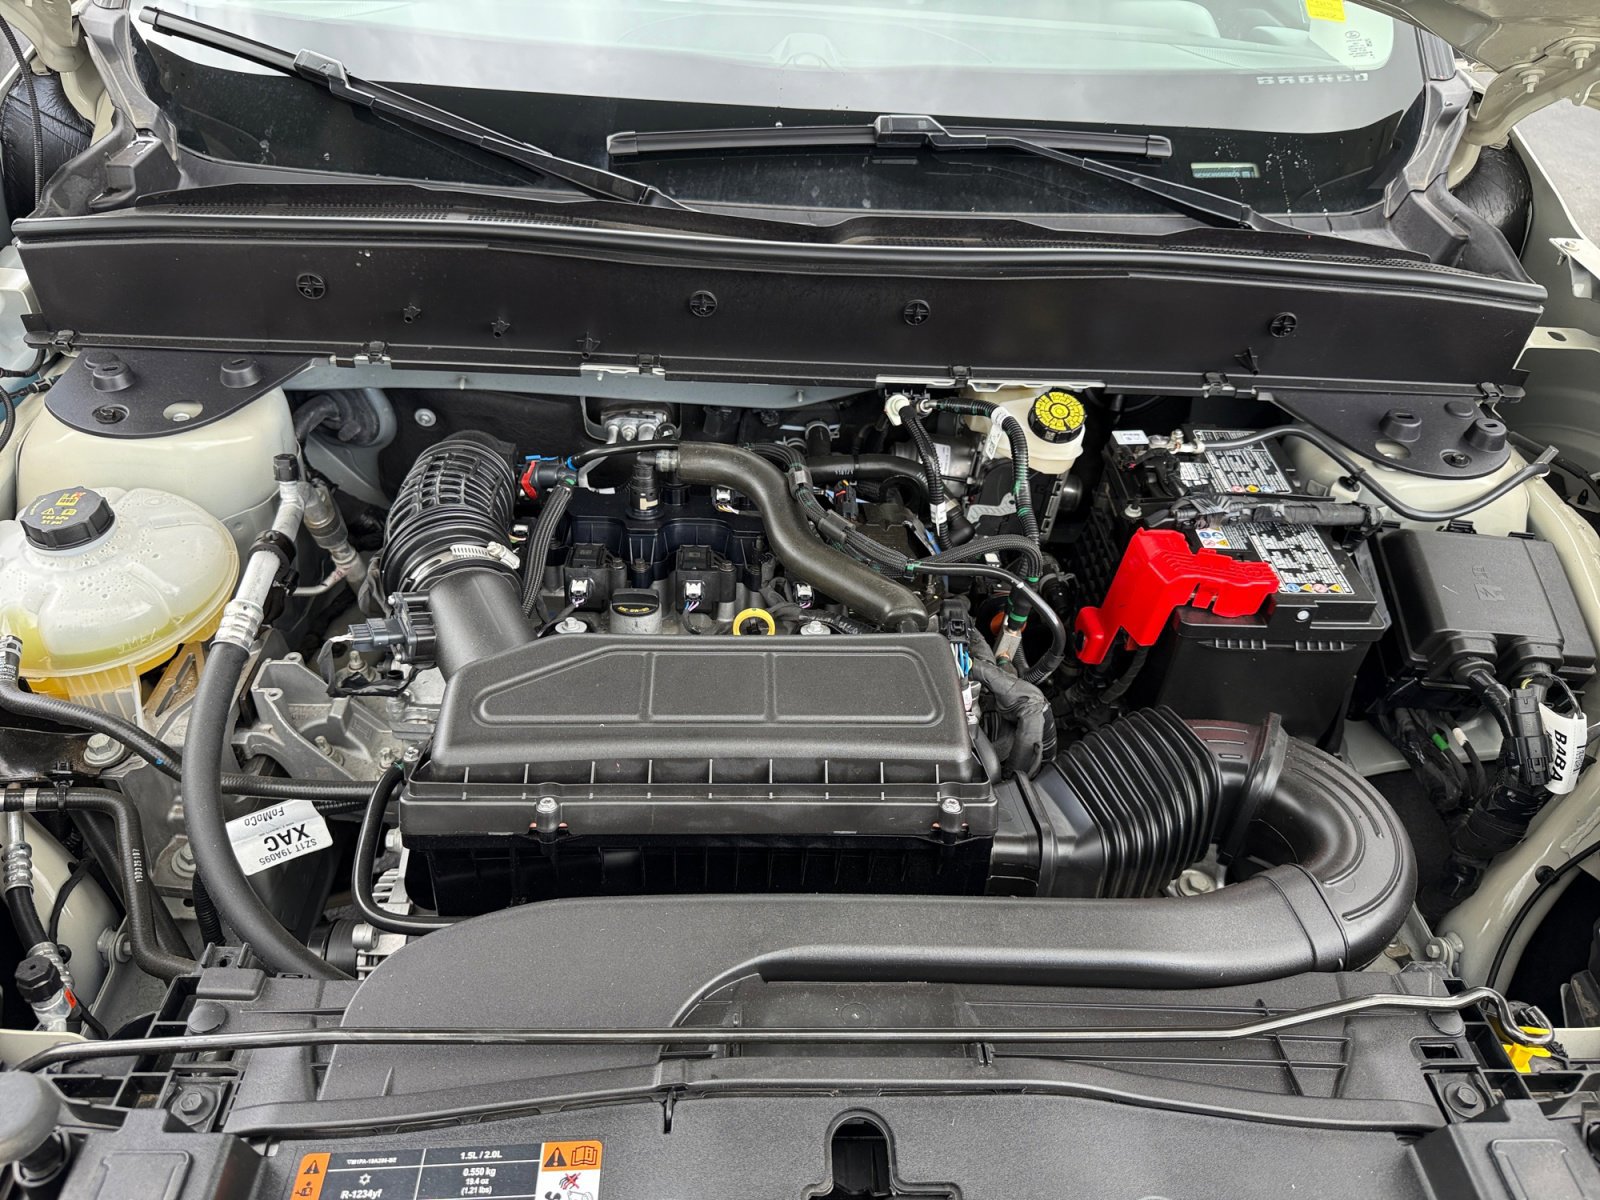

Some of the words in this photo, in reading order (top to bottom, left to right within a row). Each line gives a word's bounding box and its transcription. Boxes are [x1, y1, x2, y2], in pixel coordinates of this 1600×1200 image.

[1256, 72, 1369, 84] BRONCO
[1550, 730, 1567, 781] BABA
[243, 806, 286, 828] FoMoCo
[263, 823, 311, 852] XAC
[295, 838, 318, 853] SZ1T
[258, 847, 292, 866] 19A095
[460, 1151, 478, 1160] 1.5L
[483, 1150, 503, 1159] 2.0L
[462, 1167, 485, 1177] 0.550
[485, 1166, 497, 1178] kg
[340, 1188, 383, 1200] R-1234yf
[460, 1186, 478, 1196] (1.21
[478, 1185, 493, 1195] lbs)
